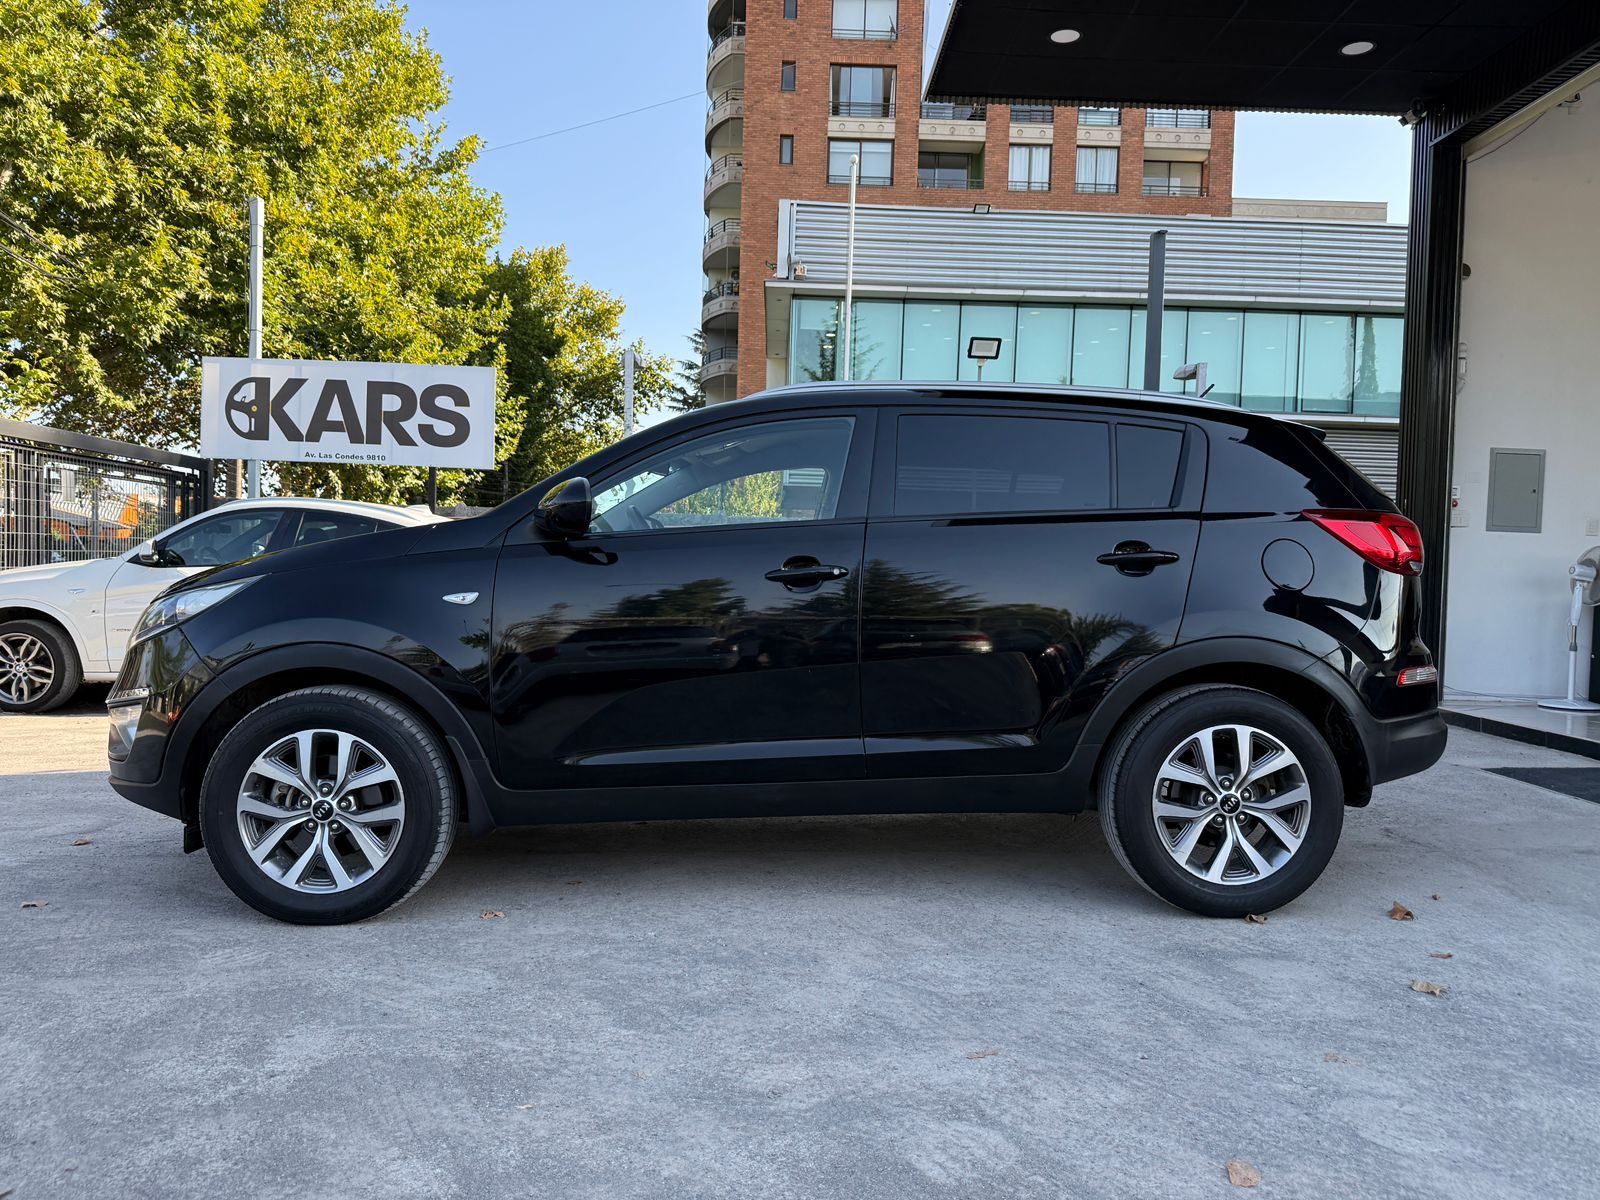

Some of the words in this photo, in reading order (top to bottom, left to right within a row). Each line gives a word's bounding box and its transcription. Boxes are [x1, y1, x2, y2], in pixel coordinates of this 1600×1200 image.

[254, 377, 471, 448] KARS
[304, 451, 316, 459] Av.
[334, 453, 364, 461] Condes
[366, 454, 386, 462] 9810
[315, 802, 331, 818] KIA
[1223, 797, 1238, 812] KIA
